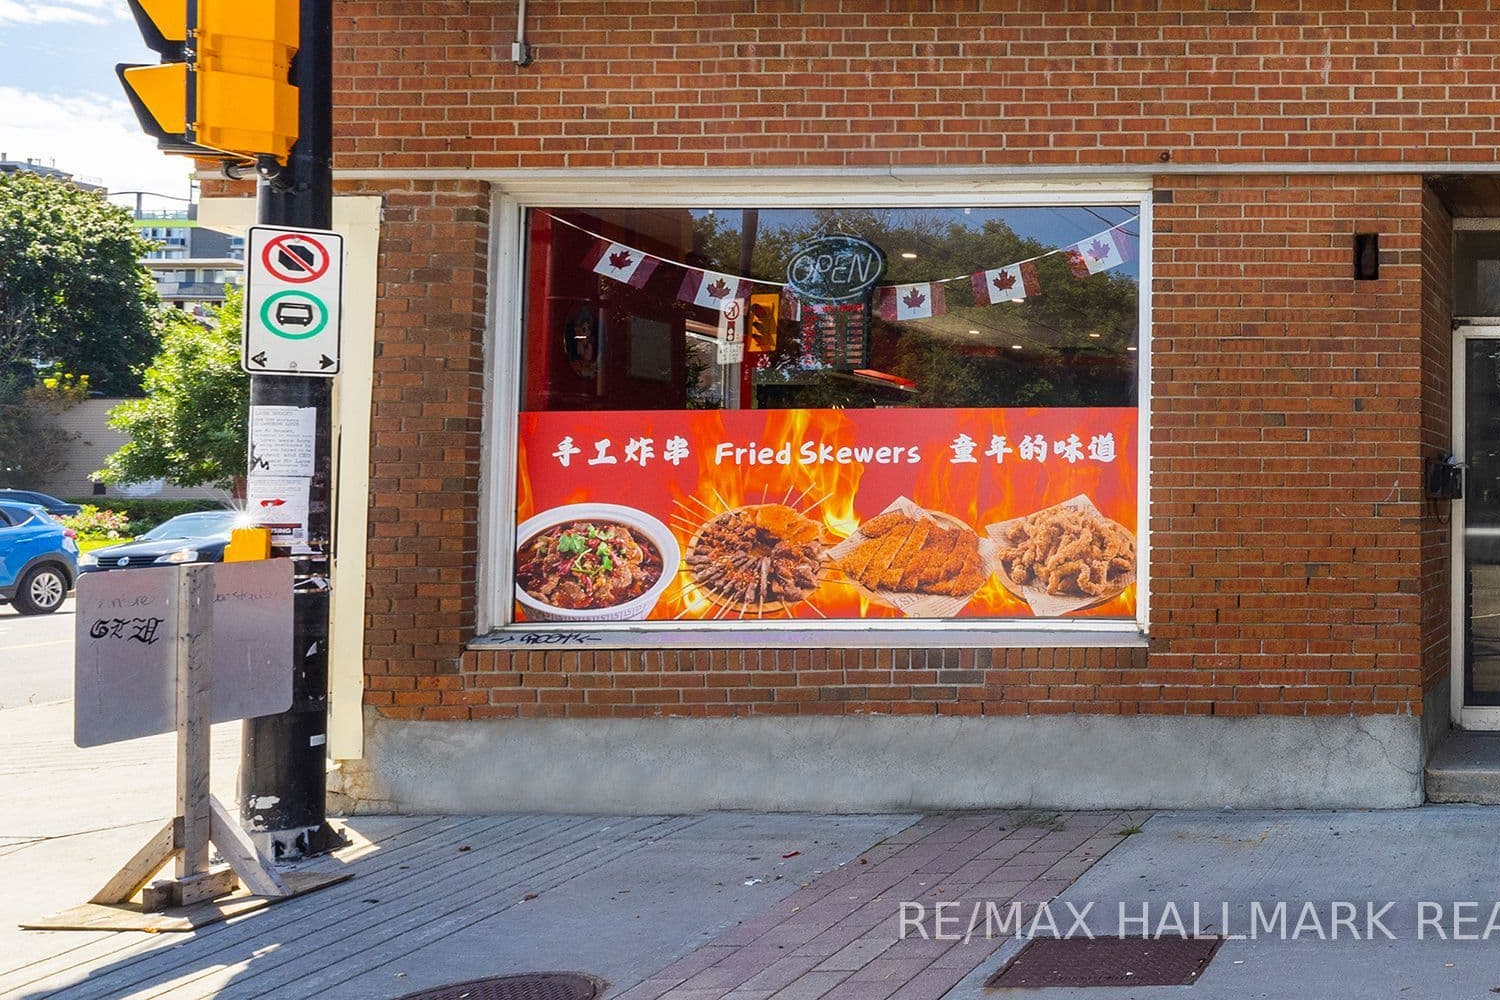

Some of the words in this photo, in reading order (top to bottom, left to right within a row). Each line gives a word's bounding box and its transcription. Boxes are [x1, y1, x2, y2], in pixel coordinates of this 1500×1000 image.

[793, 254, 873, 283] OPEN
[552, 436, 689, 466] 手工炸串
[715, 442, 790, 465] Fried
[800, 441, 921, 464] Skewers
[950, 433, 1116, 463] 童年的味道
